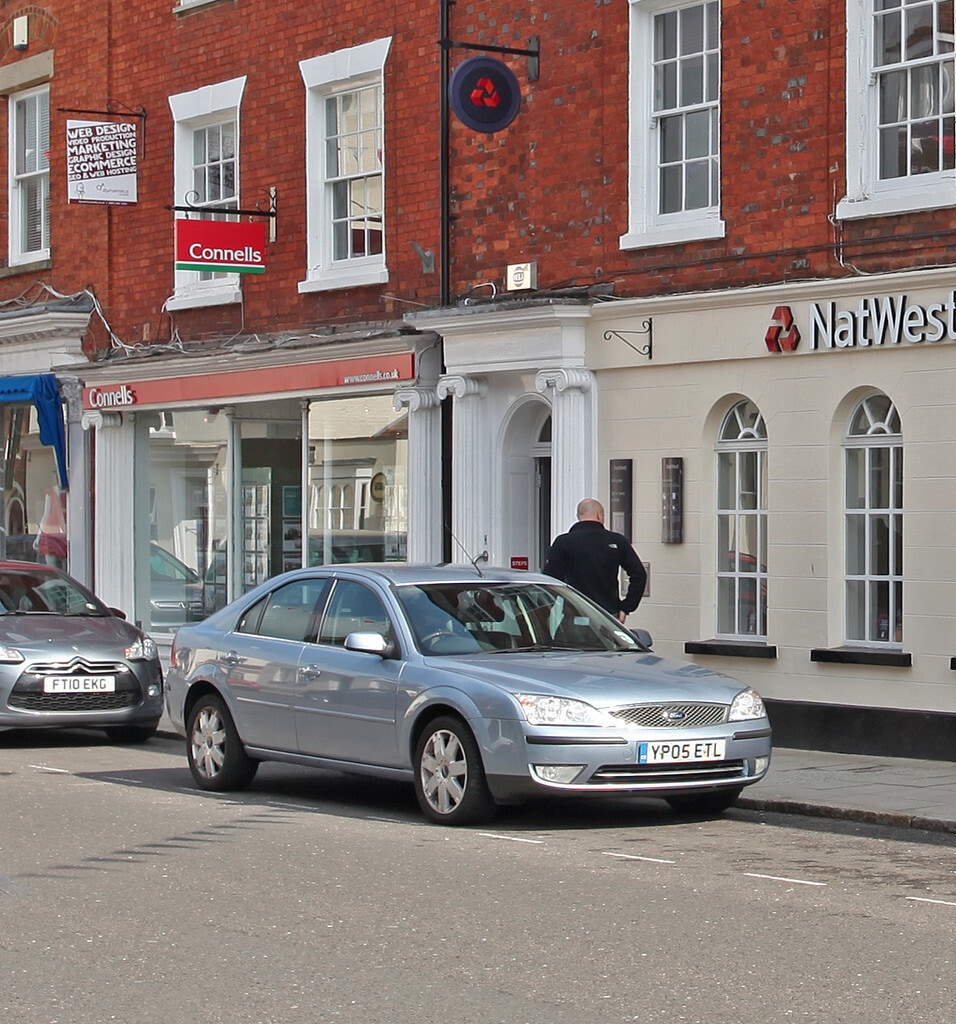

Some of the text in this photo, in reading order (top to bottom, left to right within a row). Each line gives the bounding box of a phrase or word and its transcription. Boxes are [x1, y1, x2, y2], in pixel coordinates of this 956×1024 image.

[68, 123, 136, 139] WEB DESIGN
[68, 132, 136, 146] VIDEO PRODUCTION
[68, 138, 136, 156] MARKETING
[68, 149, 136, 164] GRAPHIC DESIGN
[68, 156, 137, 174] ECOMMERCE
[90, 170, 105, 178] WEB
[107, 166, 137, 176] HOSTING
[189, 243, 262, 263] Connells
[89, 385, 135, 407] Connells
[52, 678, 107, 690] FT10 EKG
[651, 743, 722, 760] YP05 ETL
